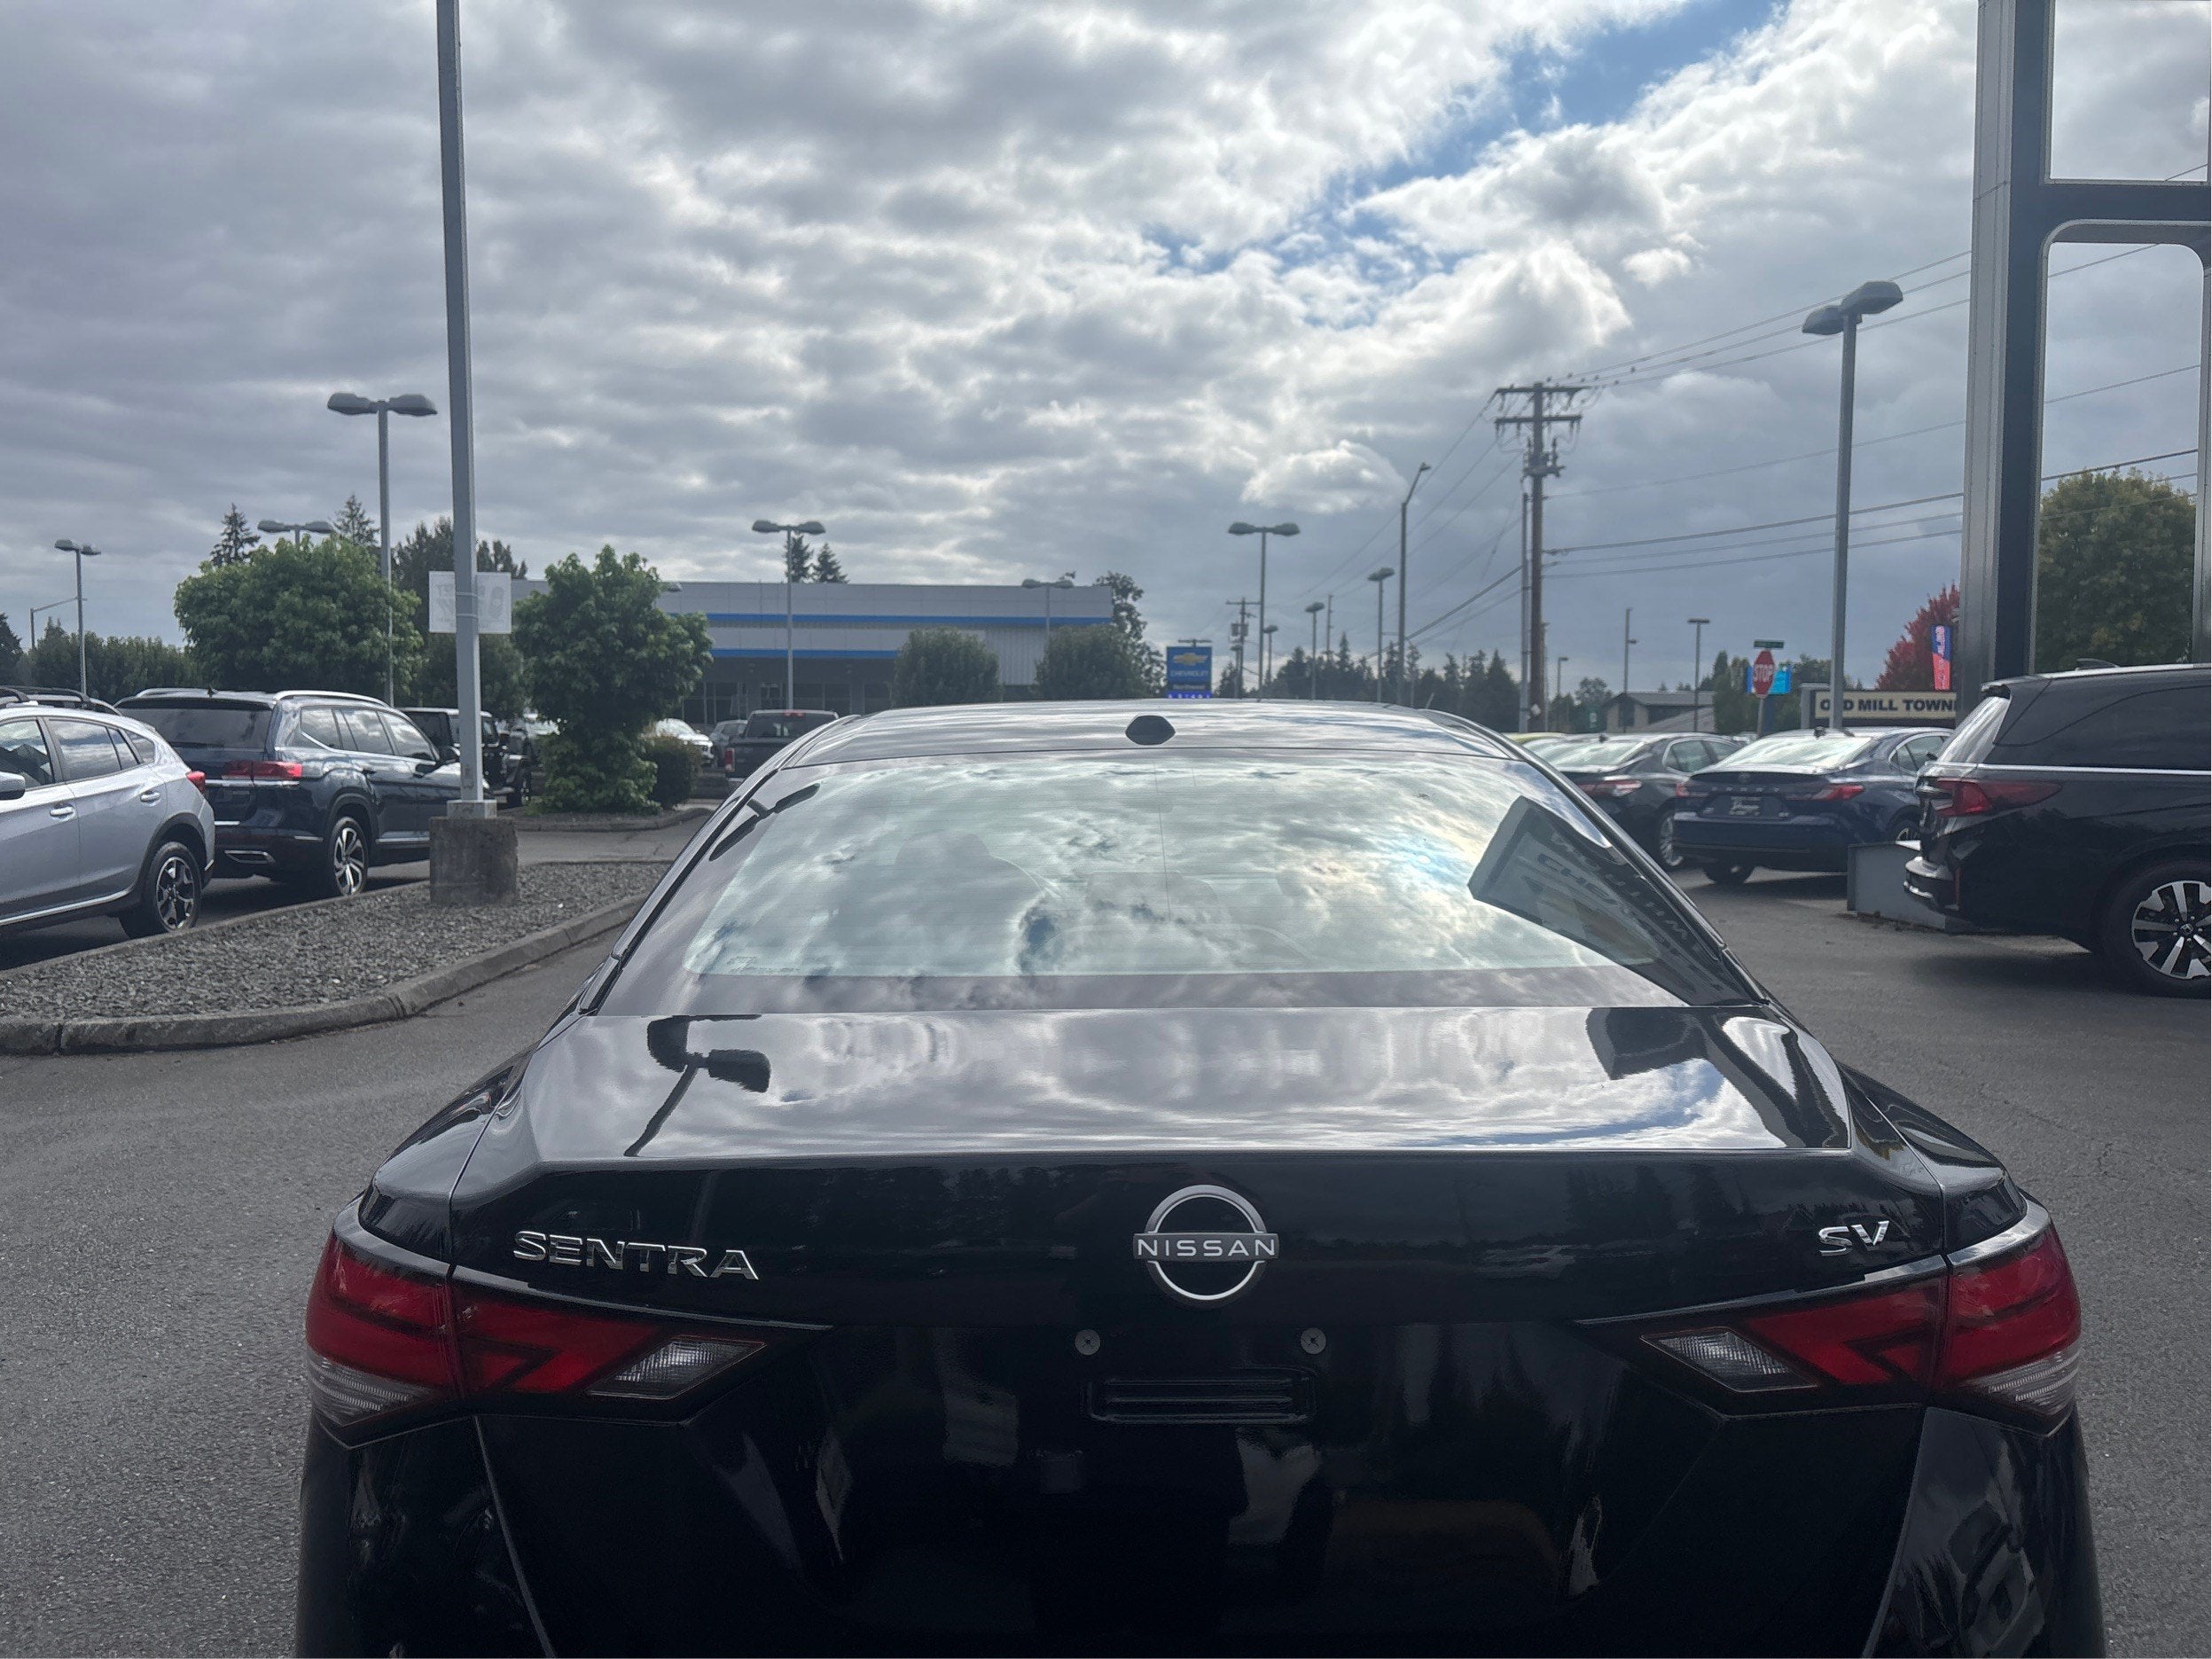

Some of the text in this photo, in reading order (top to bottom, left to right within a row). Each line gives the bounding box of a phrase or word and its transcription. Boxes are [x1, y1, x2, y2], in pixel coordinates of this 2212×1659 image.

[1754, 664, 1774, 682] STOP
[1820, 699, 1958, 711] OD MILL TOWN
[1137, 1239, 1275, 1256] NISSAN
[1817, 1220, 1889, 1257] SV
[513, 1231, 759, 1280] SENTRA
